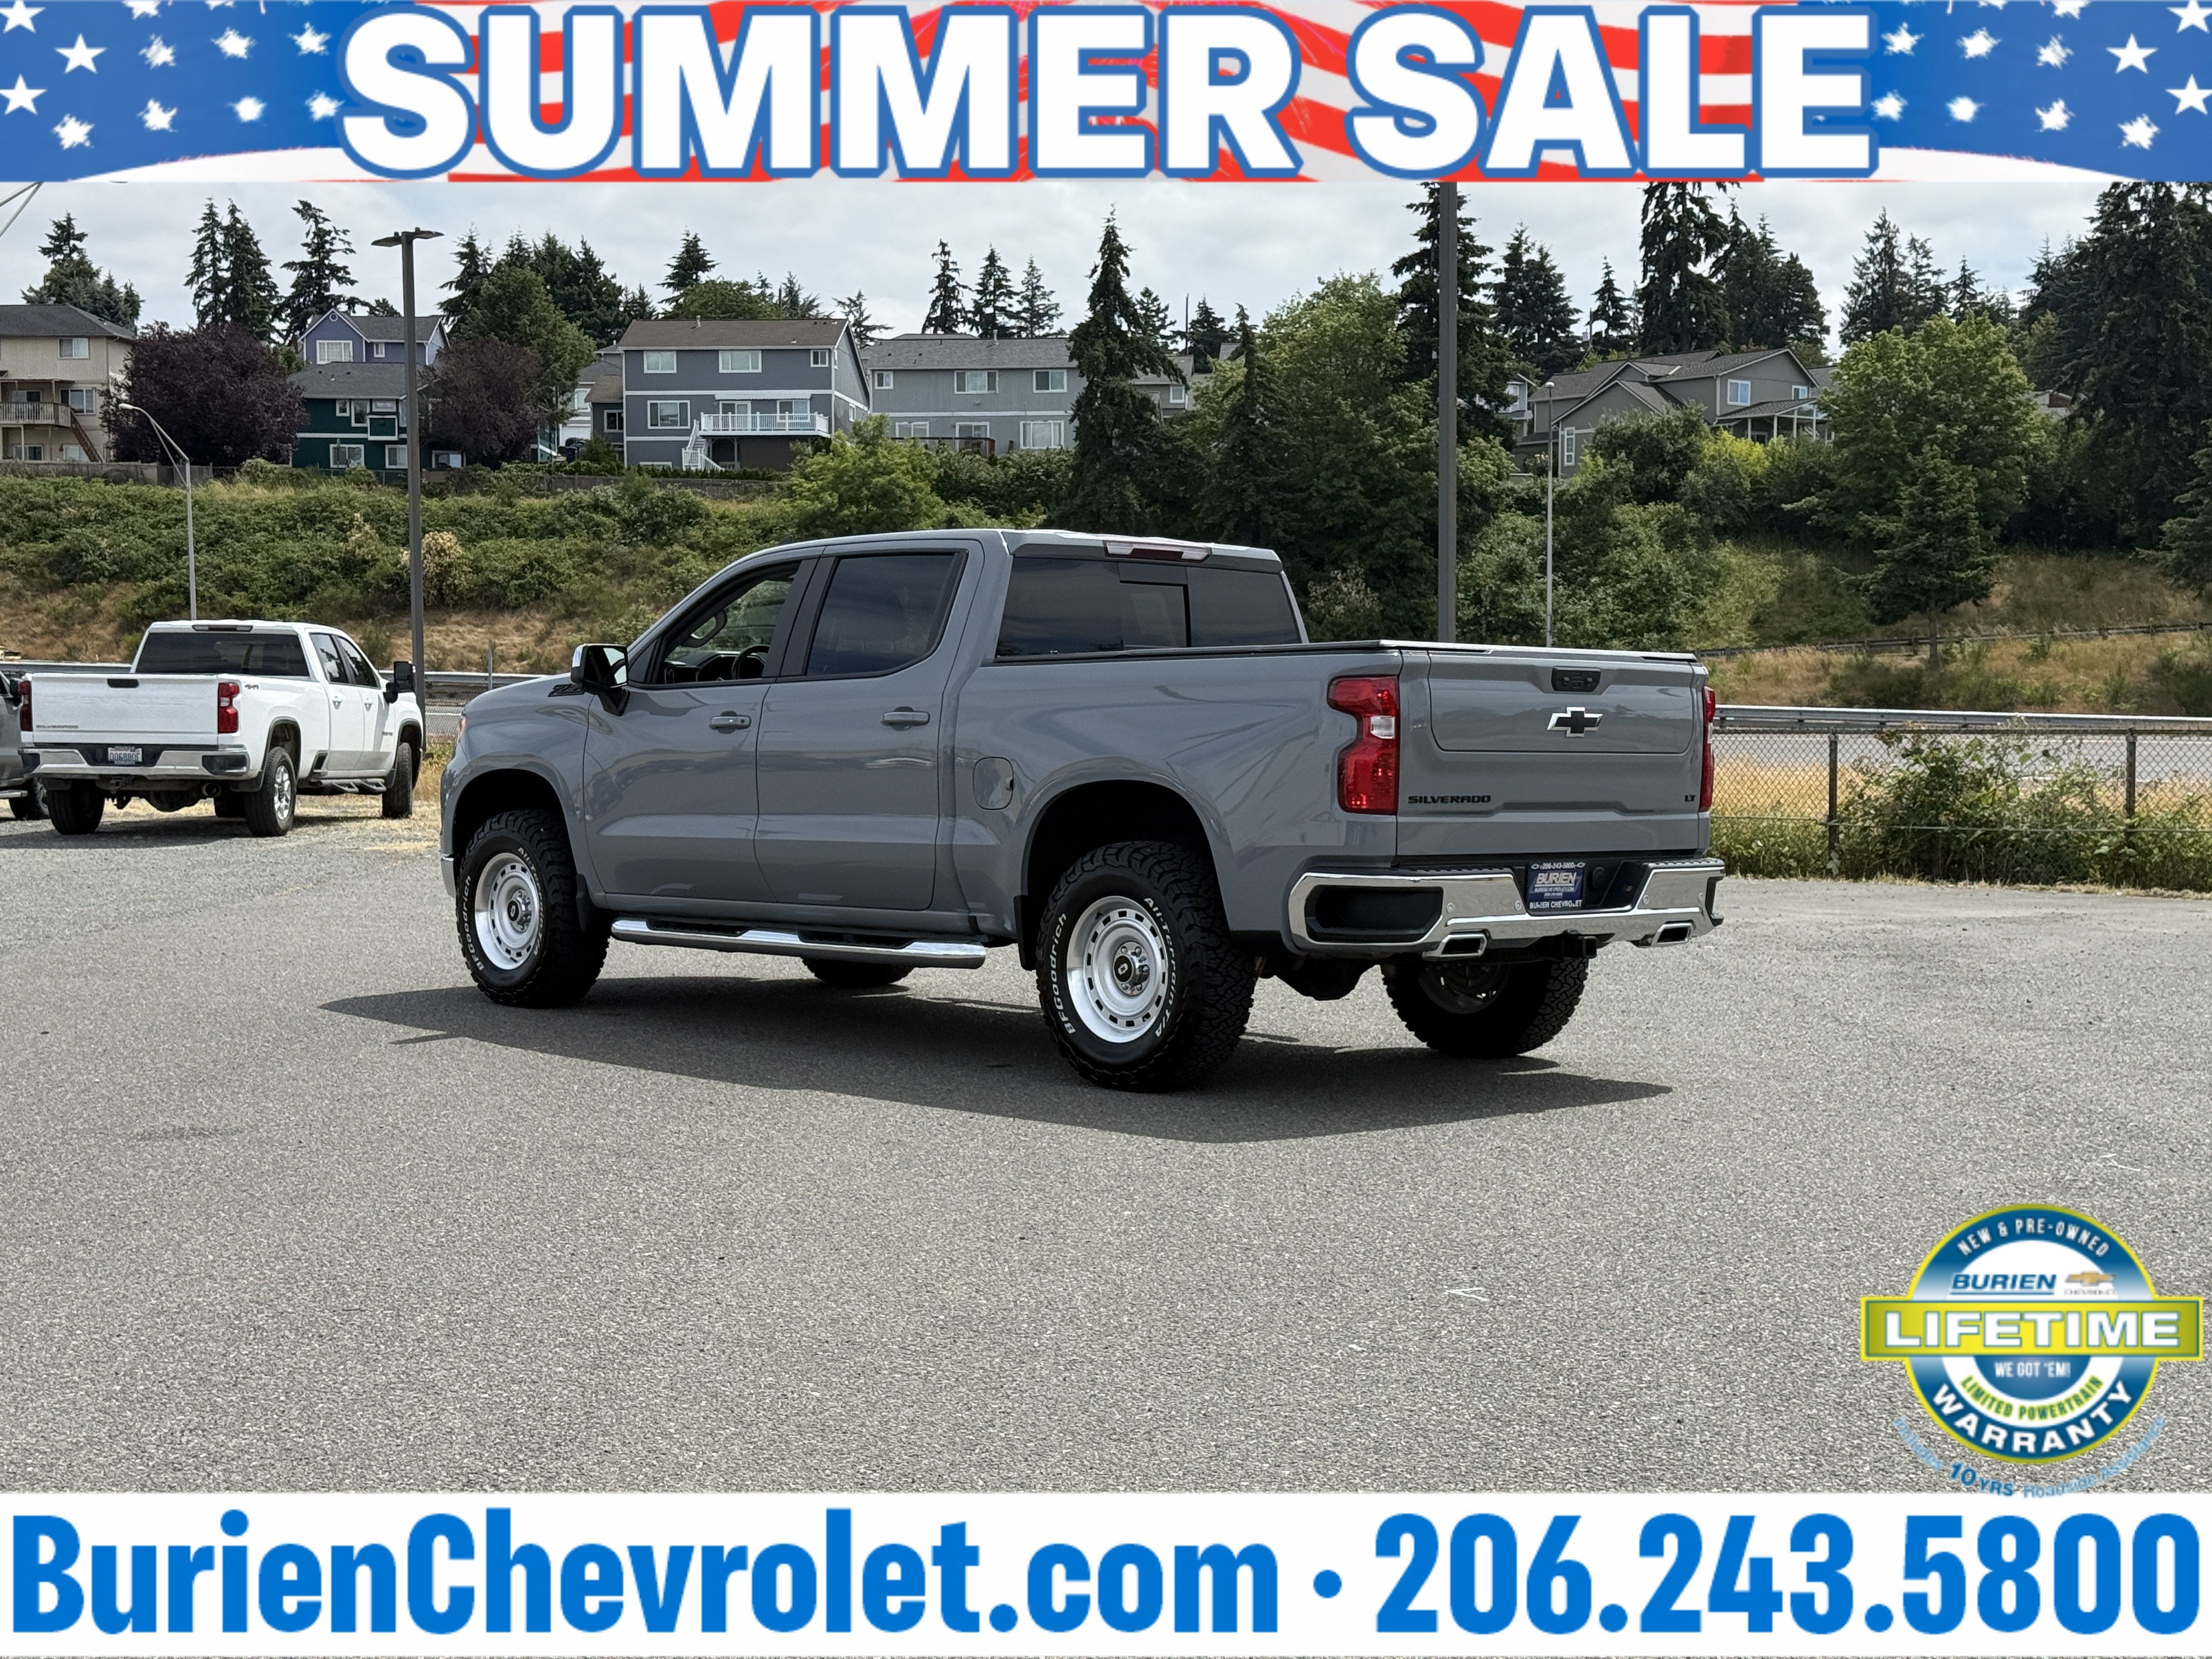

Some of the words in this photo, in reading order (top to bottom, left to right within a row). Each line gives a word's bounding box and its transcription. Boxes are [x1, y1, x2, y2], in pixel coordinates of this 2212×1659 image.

[1408, 795, 1491, 804] SILVERADO
[1536, 872, 1577, 884] BURIEN
[1550, 899, 1583, 909] CHEVROLET
[462, 875, 485, 971] BFGoodrich
[1049, 913, 1076, 1034] BFGoodrich
[1143, 897, 1176, 1006] All-Terrain
